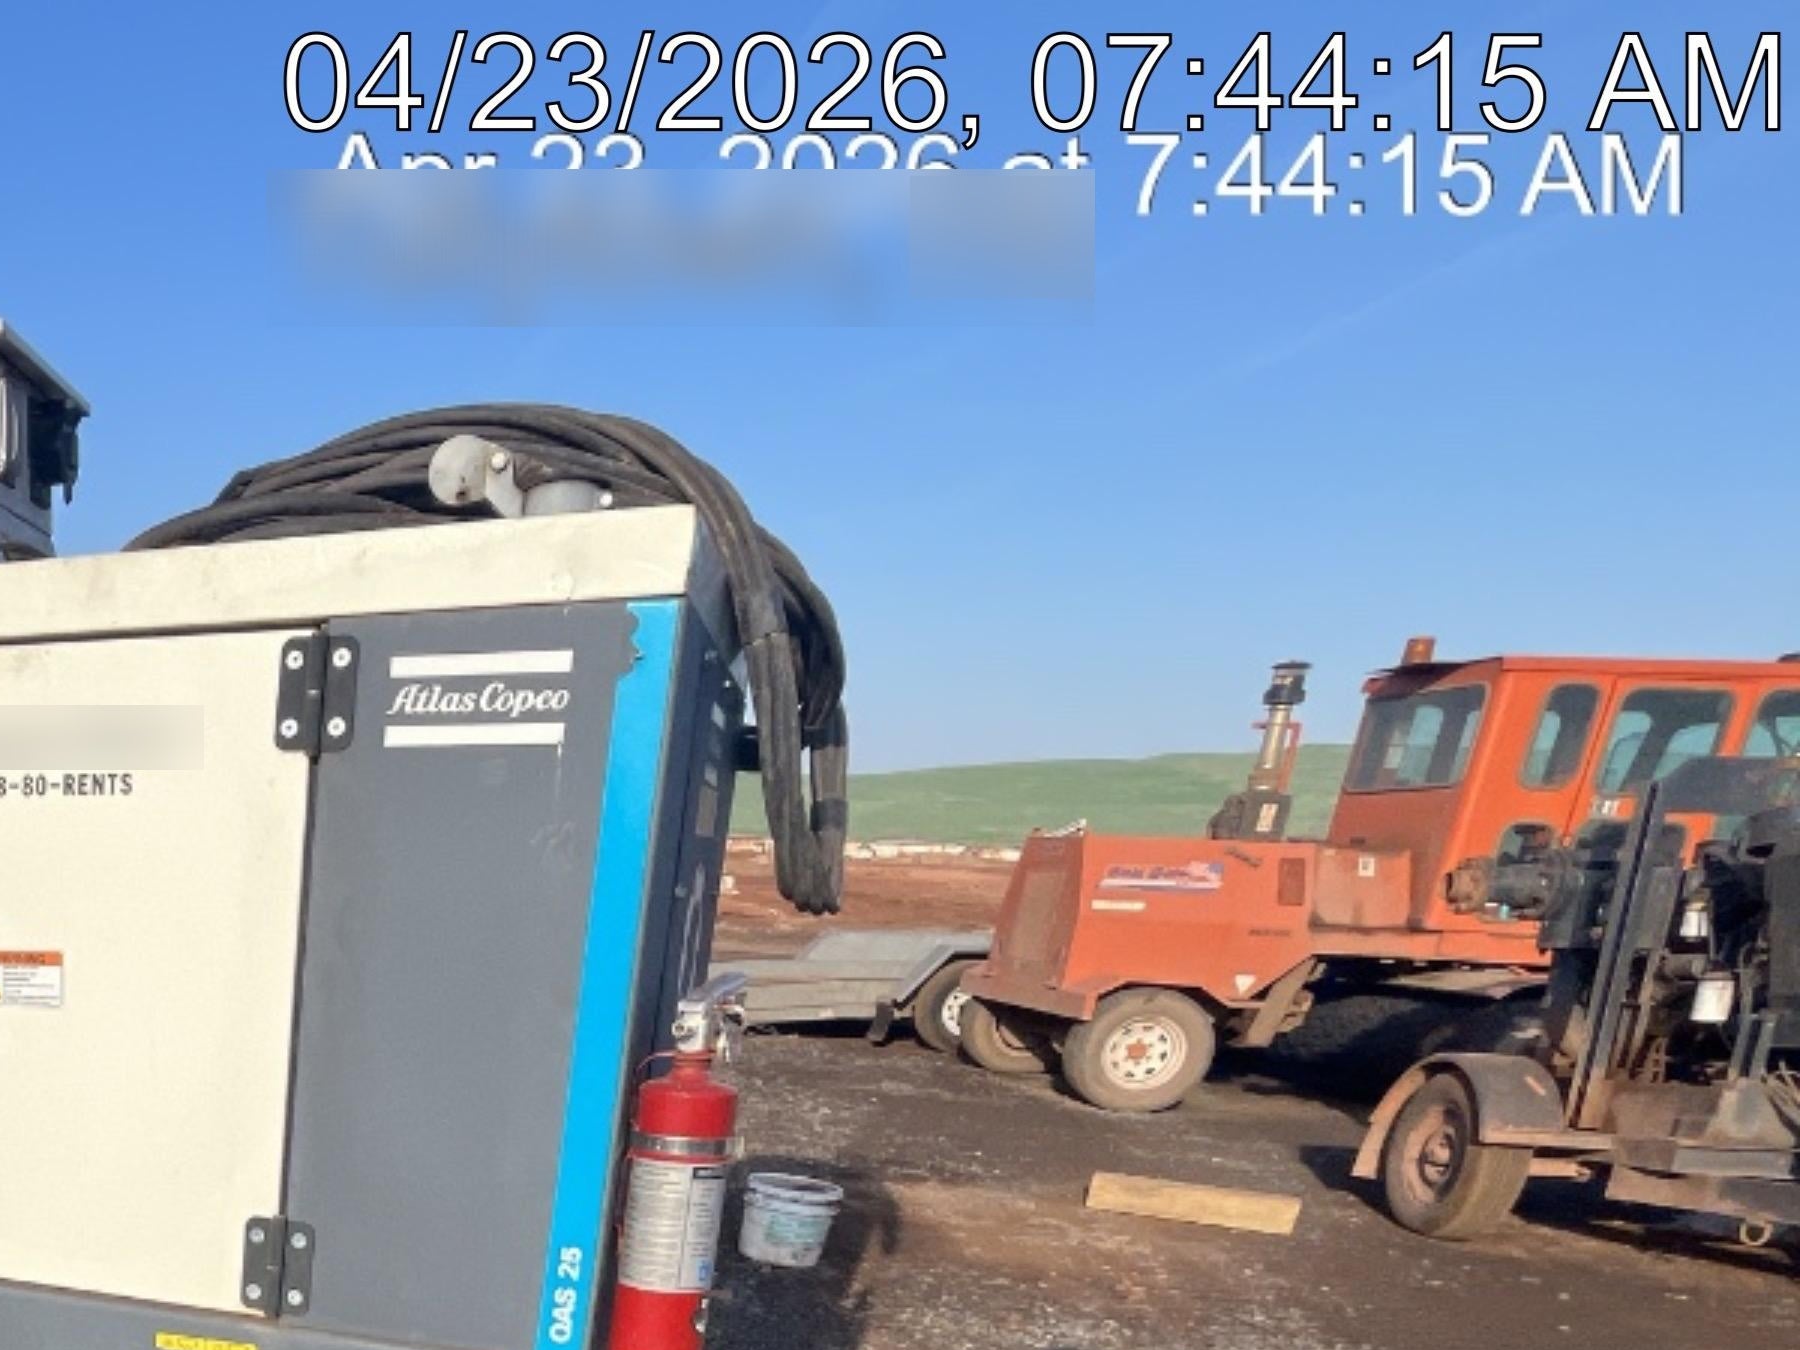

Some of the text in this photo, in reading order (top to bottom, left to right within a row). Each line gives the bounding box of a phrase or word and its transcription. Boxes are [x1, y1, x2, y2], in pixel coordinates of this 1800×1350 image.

[386, 680, 571, 718] Atlas Copco
[557, 1247, 583, 1282] 25
